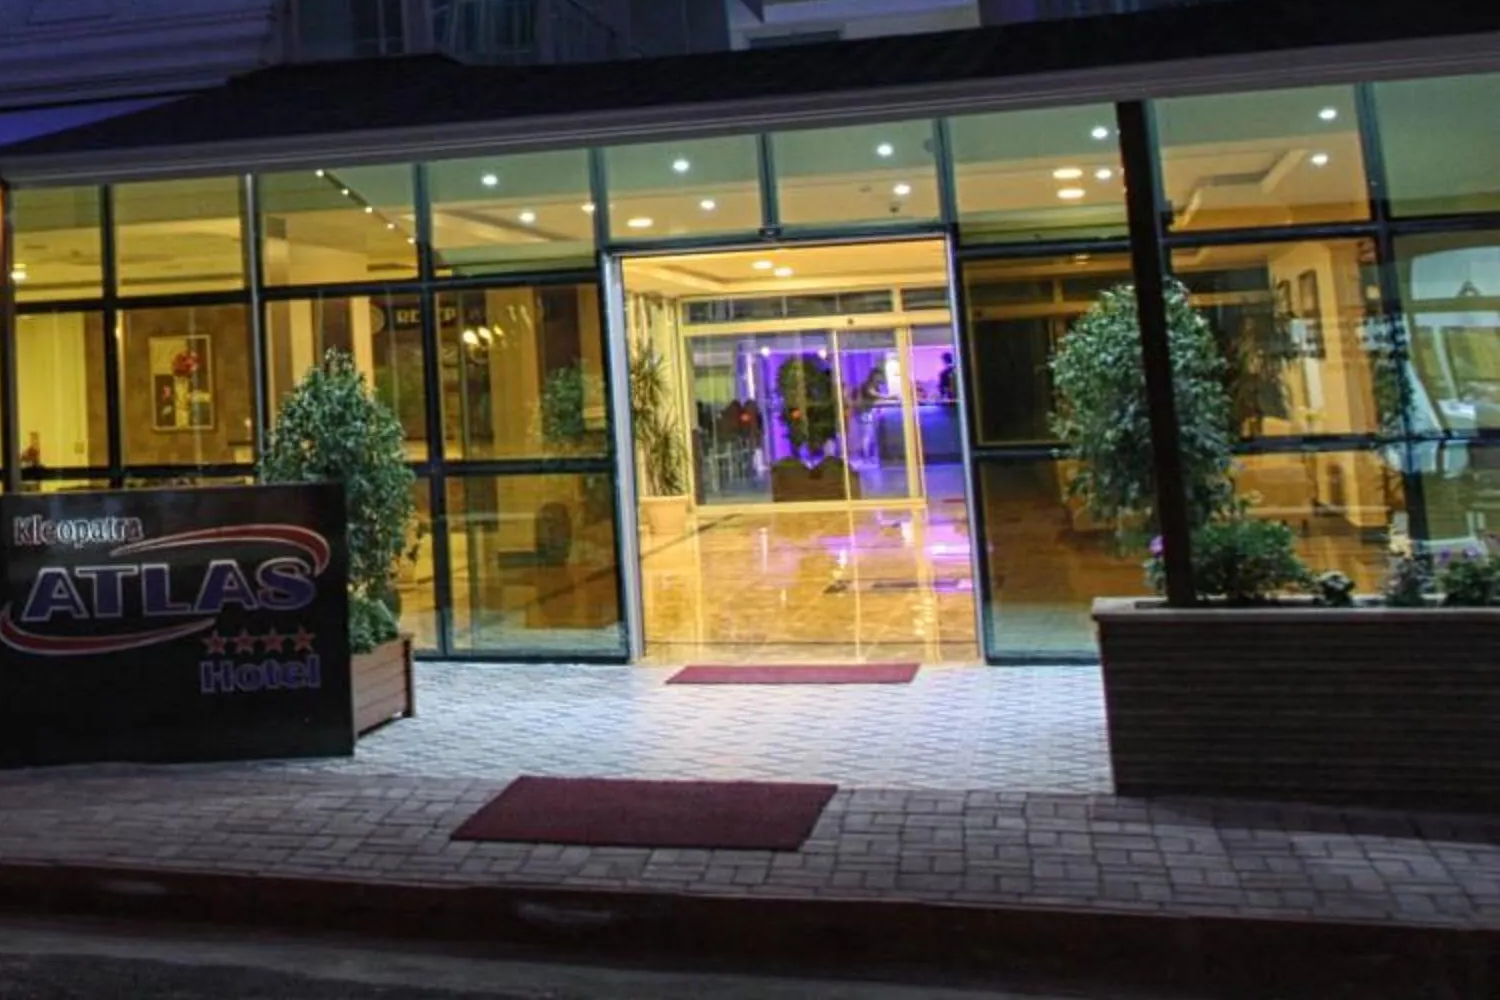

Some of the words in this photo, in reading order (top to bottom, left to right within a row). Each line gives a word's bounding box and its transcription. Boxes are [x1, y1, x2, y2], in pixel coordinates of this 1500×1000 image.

[13, 514, 144, 549] Kleopatra
[21, 557, 317, 622] ATLAS
[200, 654, 321, 693] Hotel
